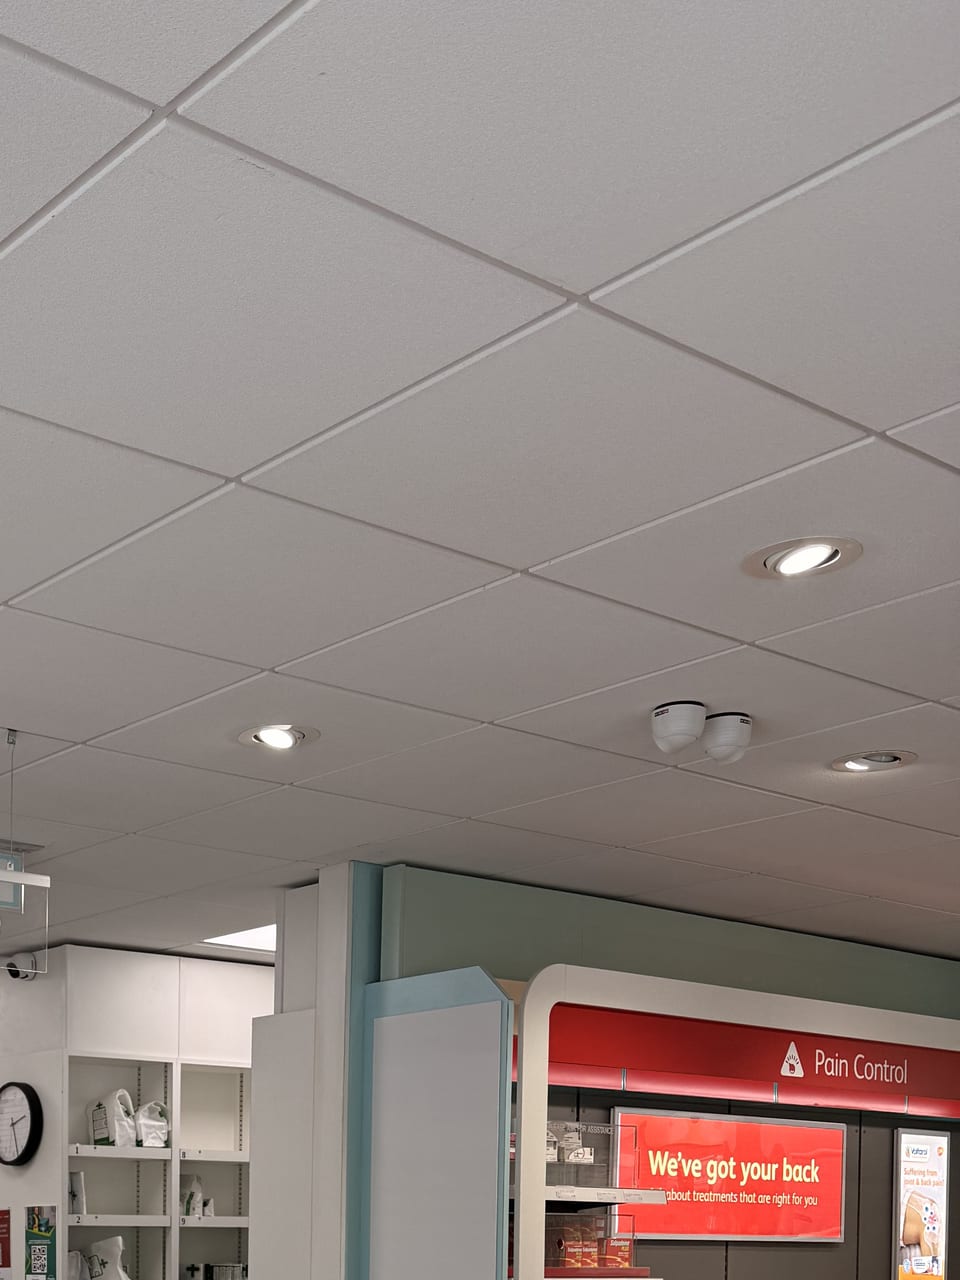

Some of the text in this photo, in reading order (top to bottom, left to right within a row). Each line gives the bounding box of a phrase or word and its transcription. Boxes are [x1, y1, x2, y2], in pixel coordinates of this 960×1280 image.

[815, 1049, 907, 1084] Pain Control
[75, 1146, 79, 1154] 1
[648, 1150, 820, 1186] We've got your back
[904, 1168, 926, 1177] Suffering
[666, 1188, 818, 1209] about treatments that are right for you
